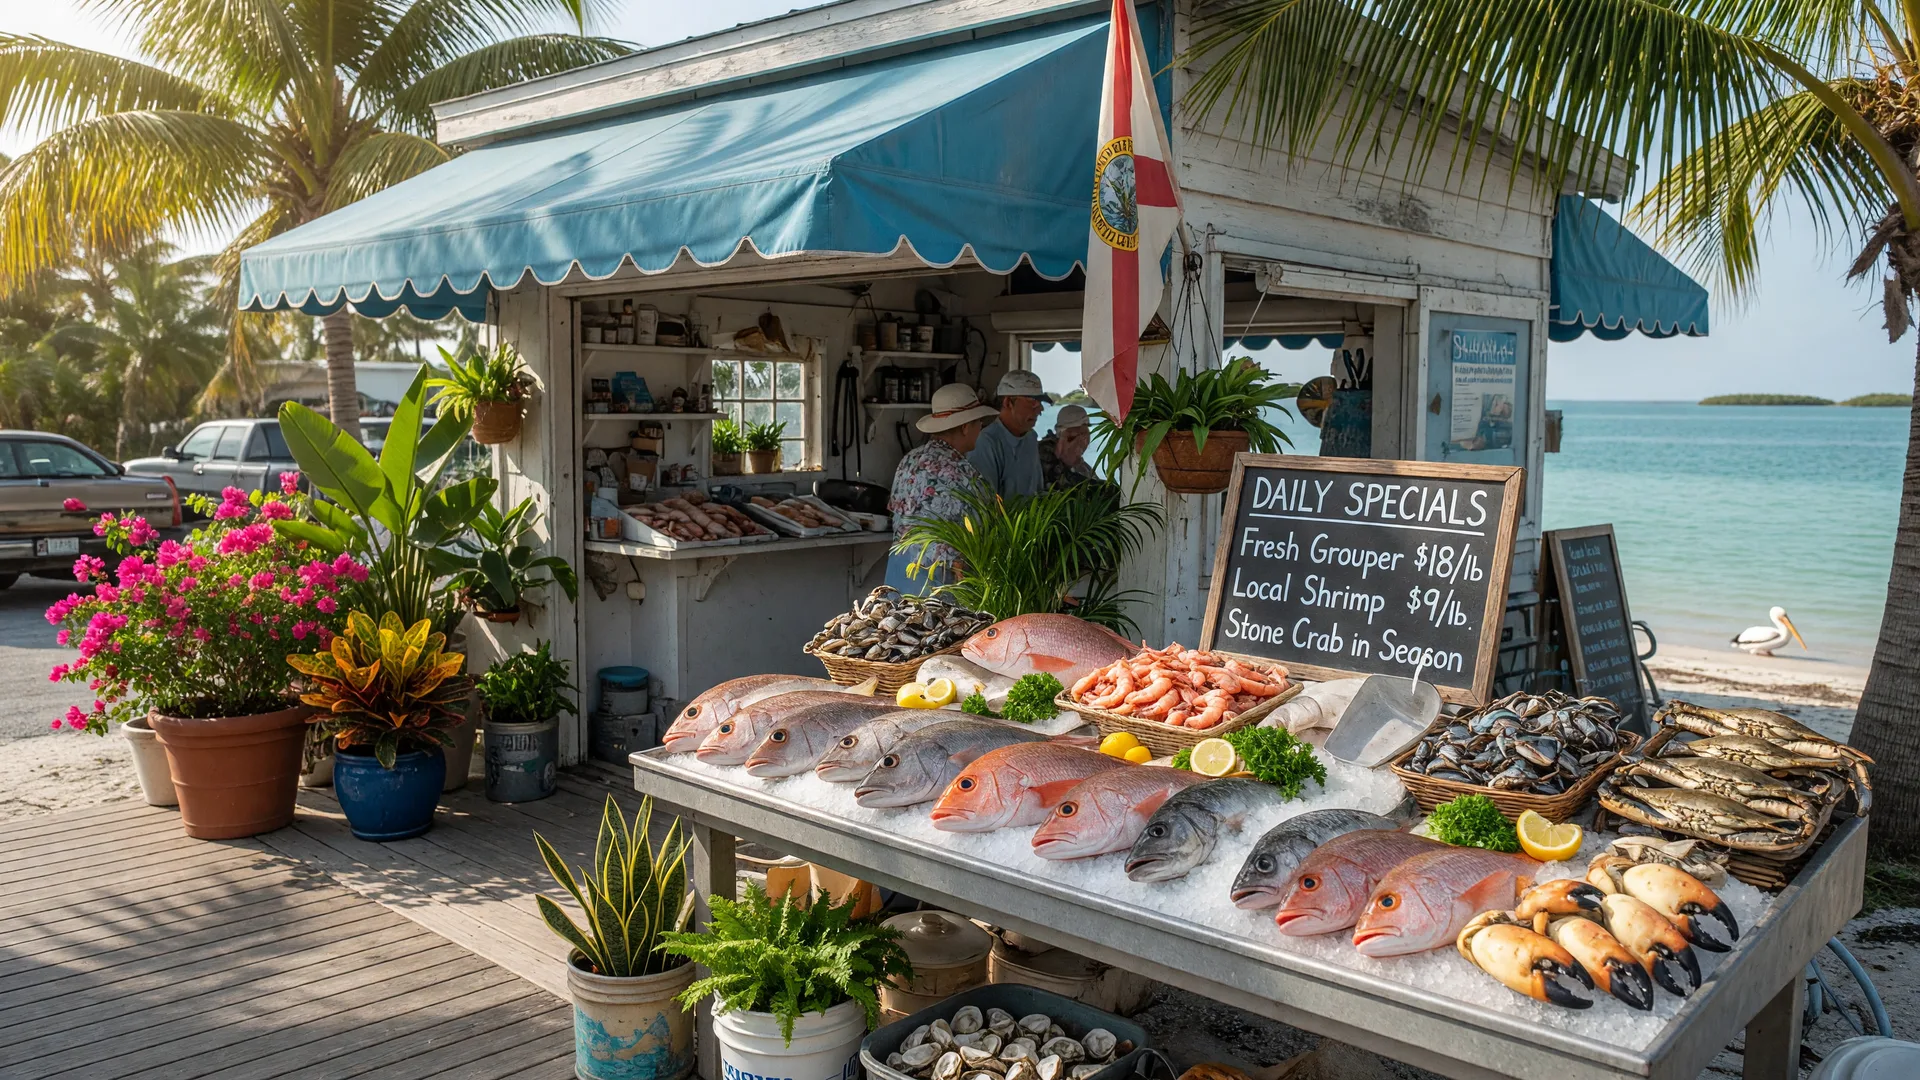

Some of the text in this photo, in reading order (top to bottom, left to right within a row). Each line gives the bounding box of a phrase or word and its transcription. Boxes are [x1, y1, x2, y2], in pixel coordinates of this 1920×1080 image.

[1253, 477, 1487, 526] DAILY SPECIALS
[1241, 527, 1483, 584] Fresh Grouper $18/lb
[1233, 568, 1291, 601] Local
[1301, 575, 1385, 624] Shrimp
[1225, 608, 1462, 672] Stone Crab in Season
